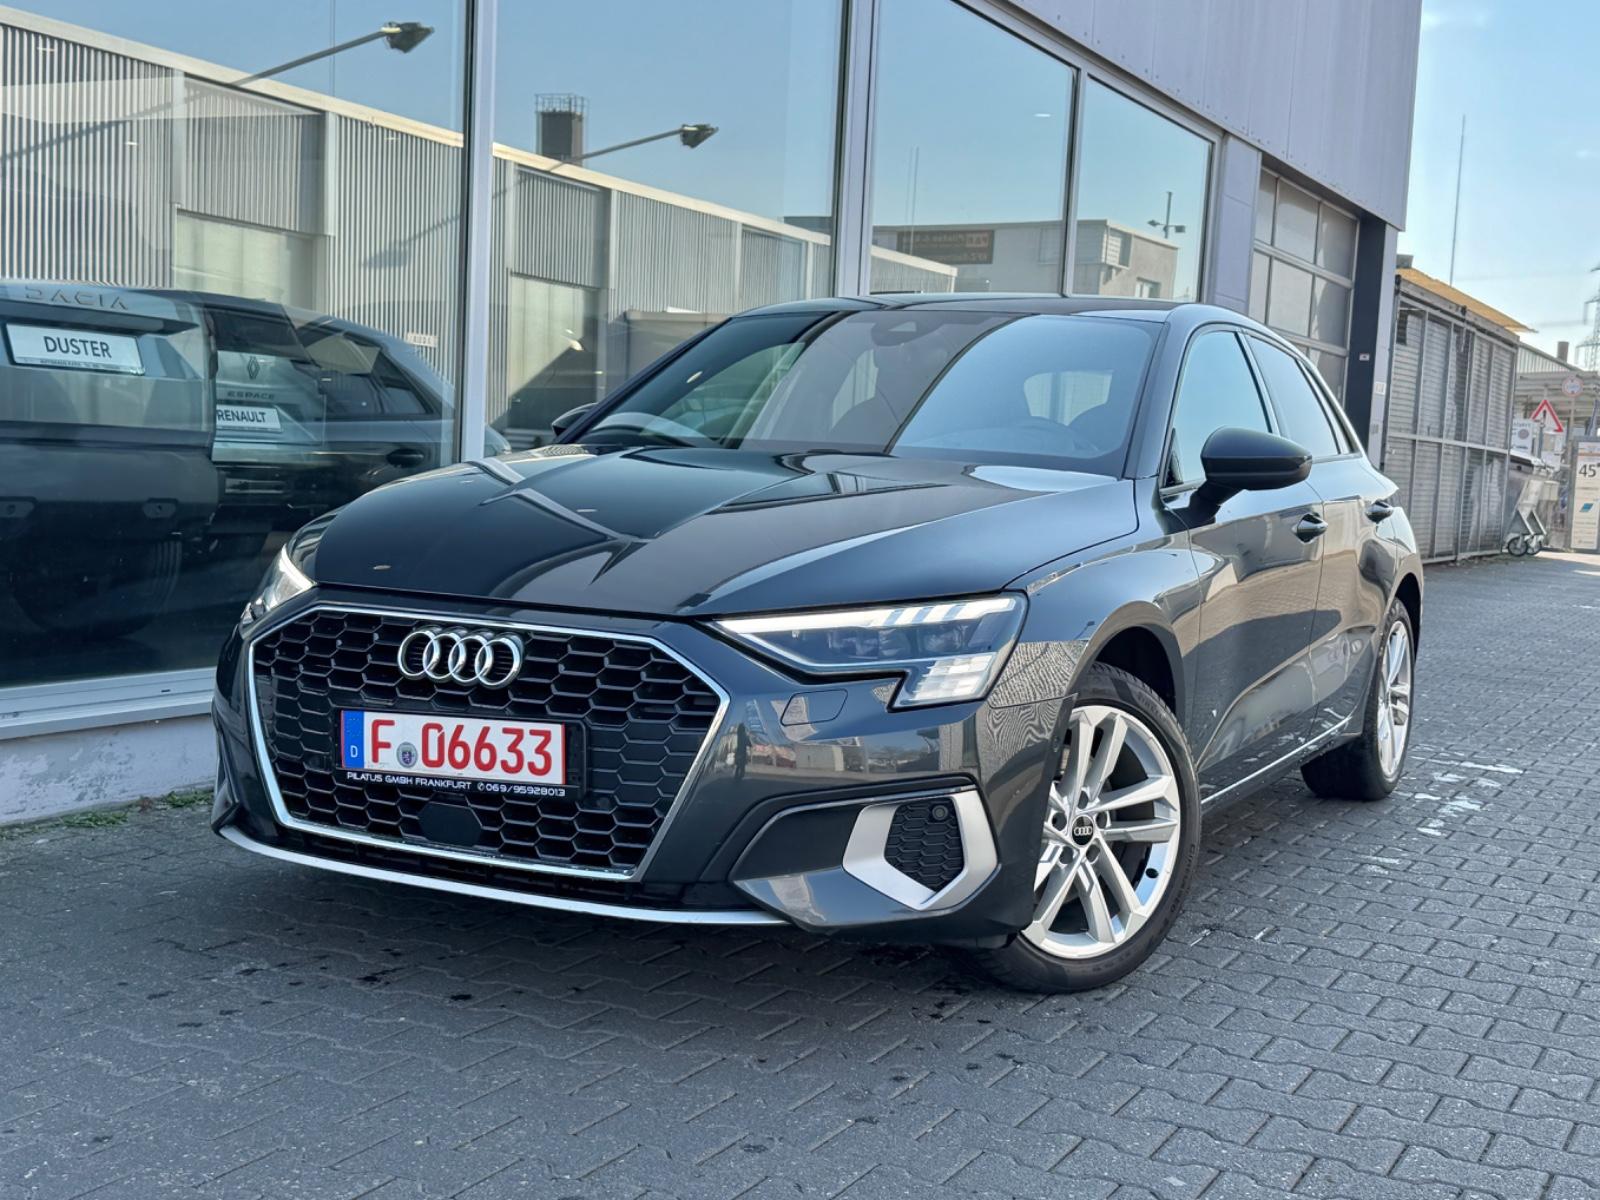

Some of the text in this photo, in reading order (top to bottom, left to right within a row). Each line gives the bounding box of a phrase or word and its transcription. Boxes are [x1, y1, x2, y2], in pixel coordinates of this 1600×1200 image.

[25, 286, 129, 310] DACIA
[43, 335, 112, 359] DUSTER
[227, 390, 275, 400] ESPACE
[216, 409, 267, 423] RENAULT
[350, 745, 358, 758] D
[371, 719, 553, 777] F 06633
[346, 771, 383, 783] PILATUS
[384, 775, 413, 785] GMBH
[415, 777, 472, 790] FRANKFURT
